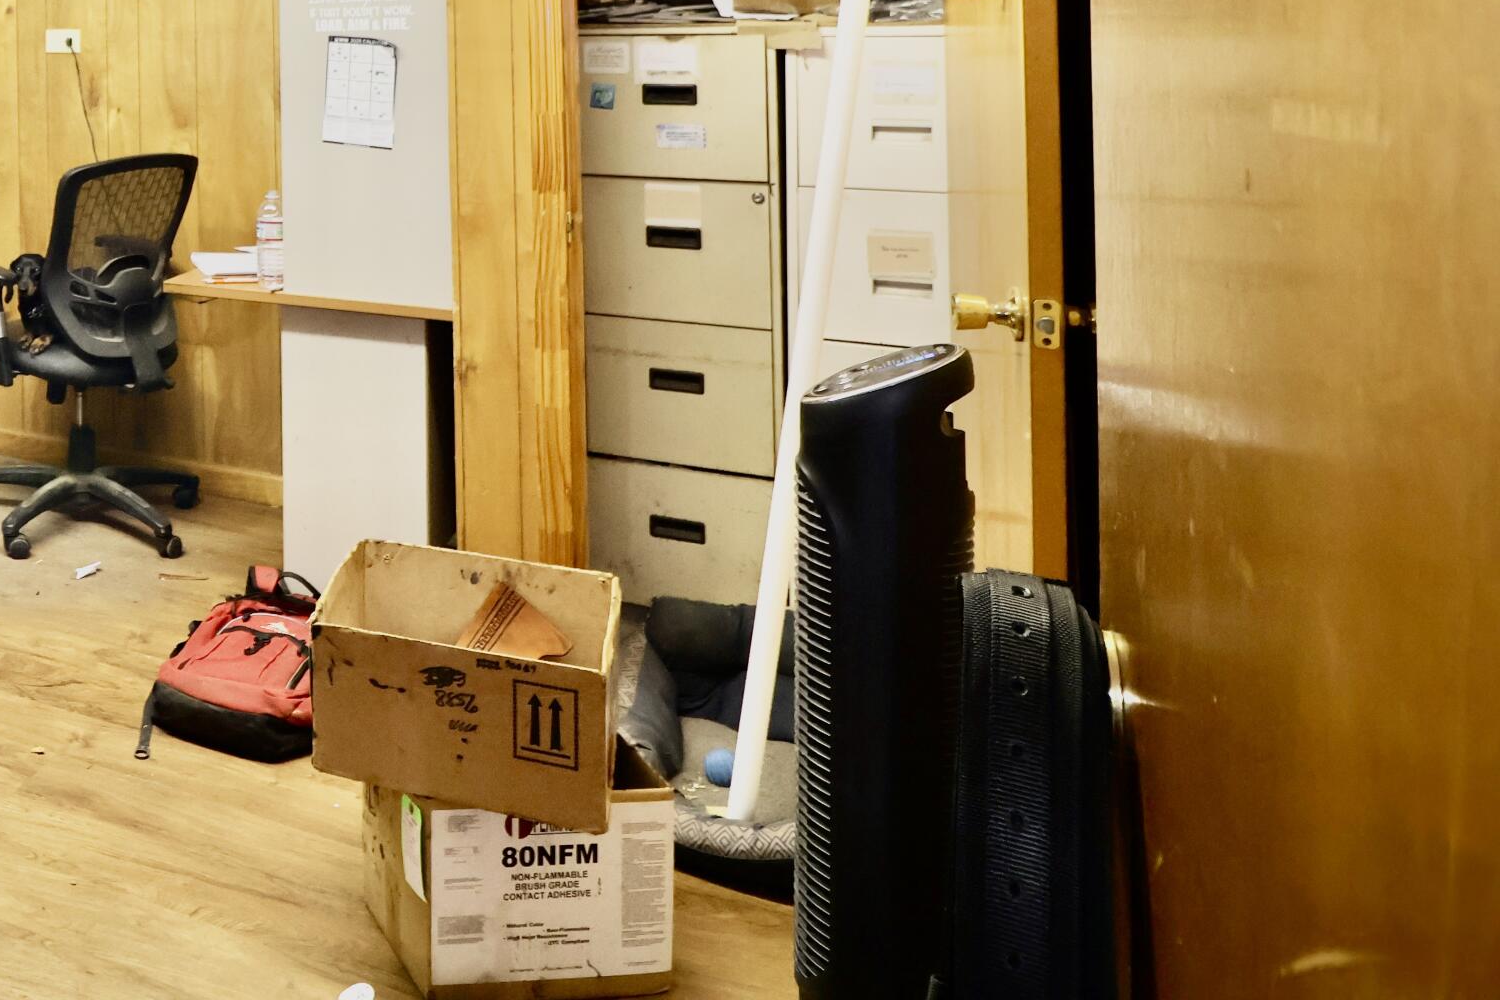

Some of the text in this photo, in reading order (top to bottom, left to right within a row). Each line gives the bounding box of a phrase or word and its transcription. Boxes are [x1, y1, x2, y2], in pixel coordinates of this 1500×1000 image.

[501, 843, 598, 868] 80NFM
[511, 870, 589, 881] NON-FLAMMABLE
[515, 880, 580, 891] BRUSH GRADE
[503, 889, 592, 901] CONTACT ADHESIVE
